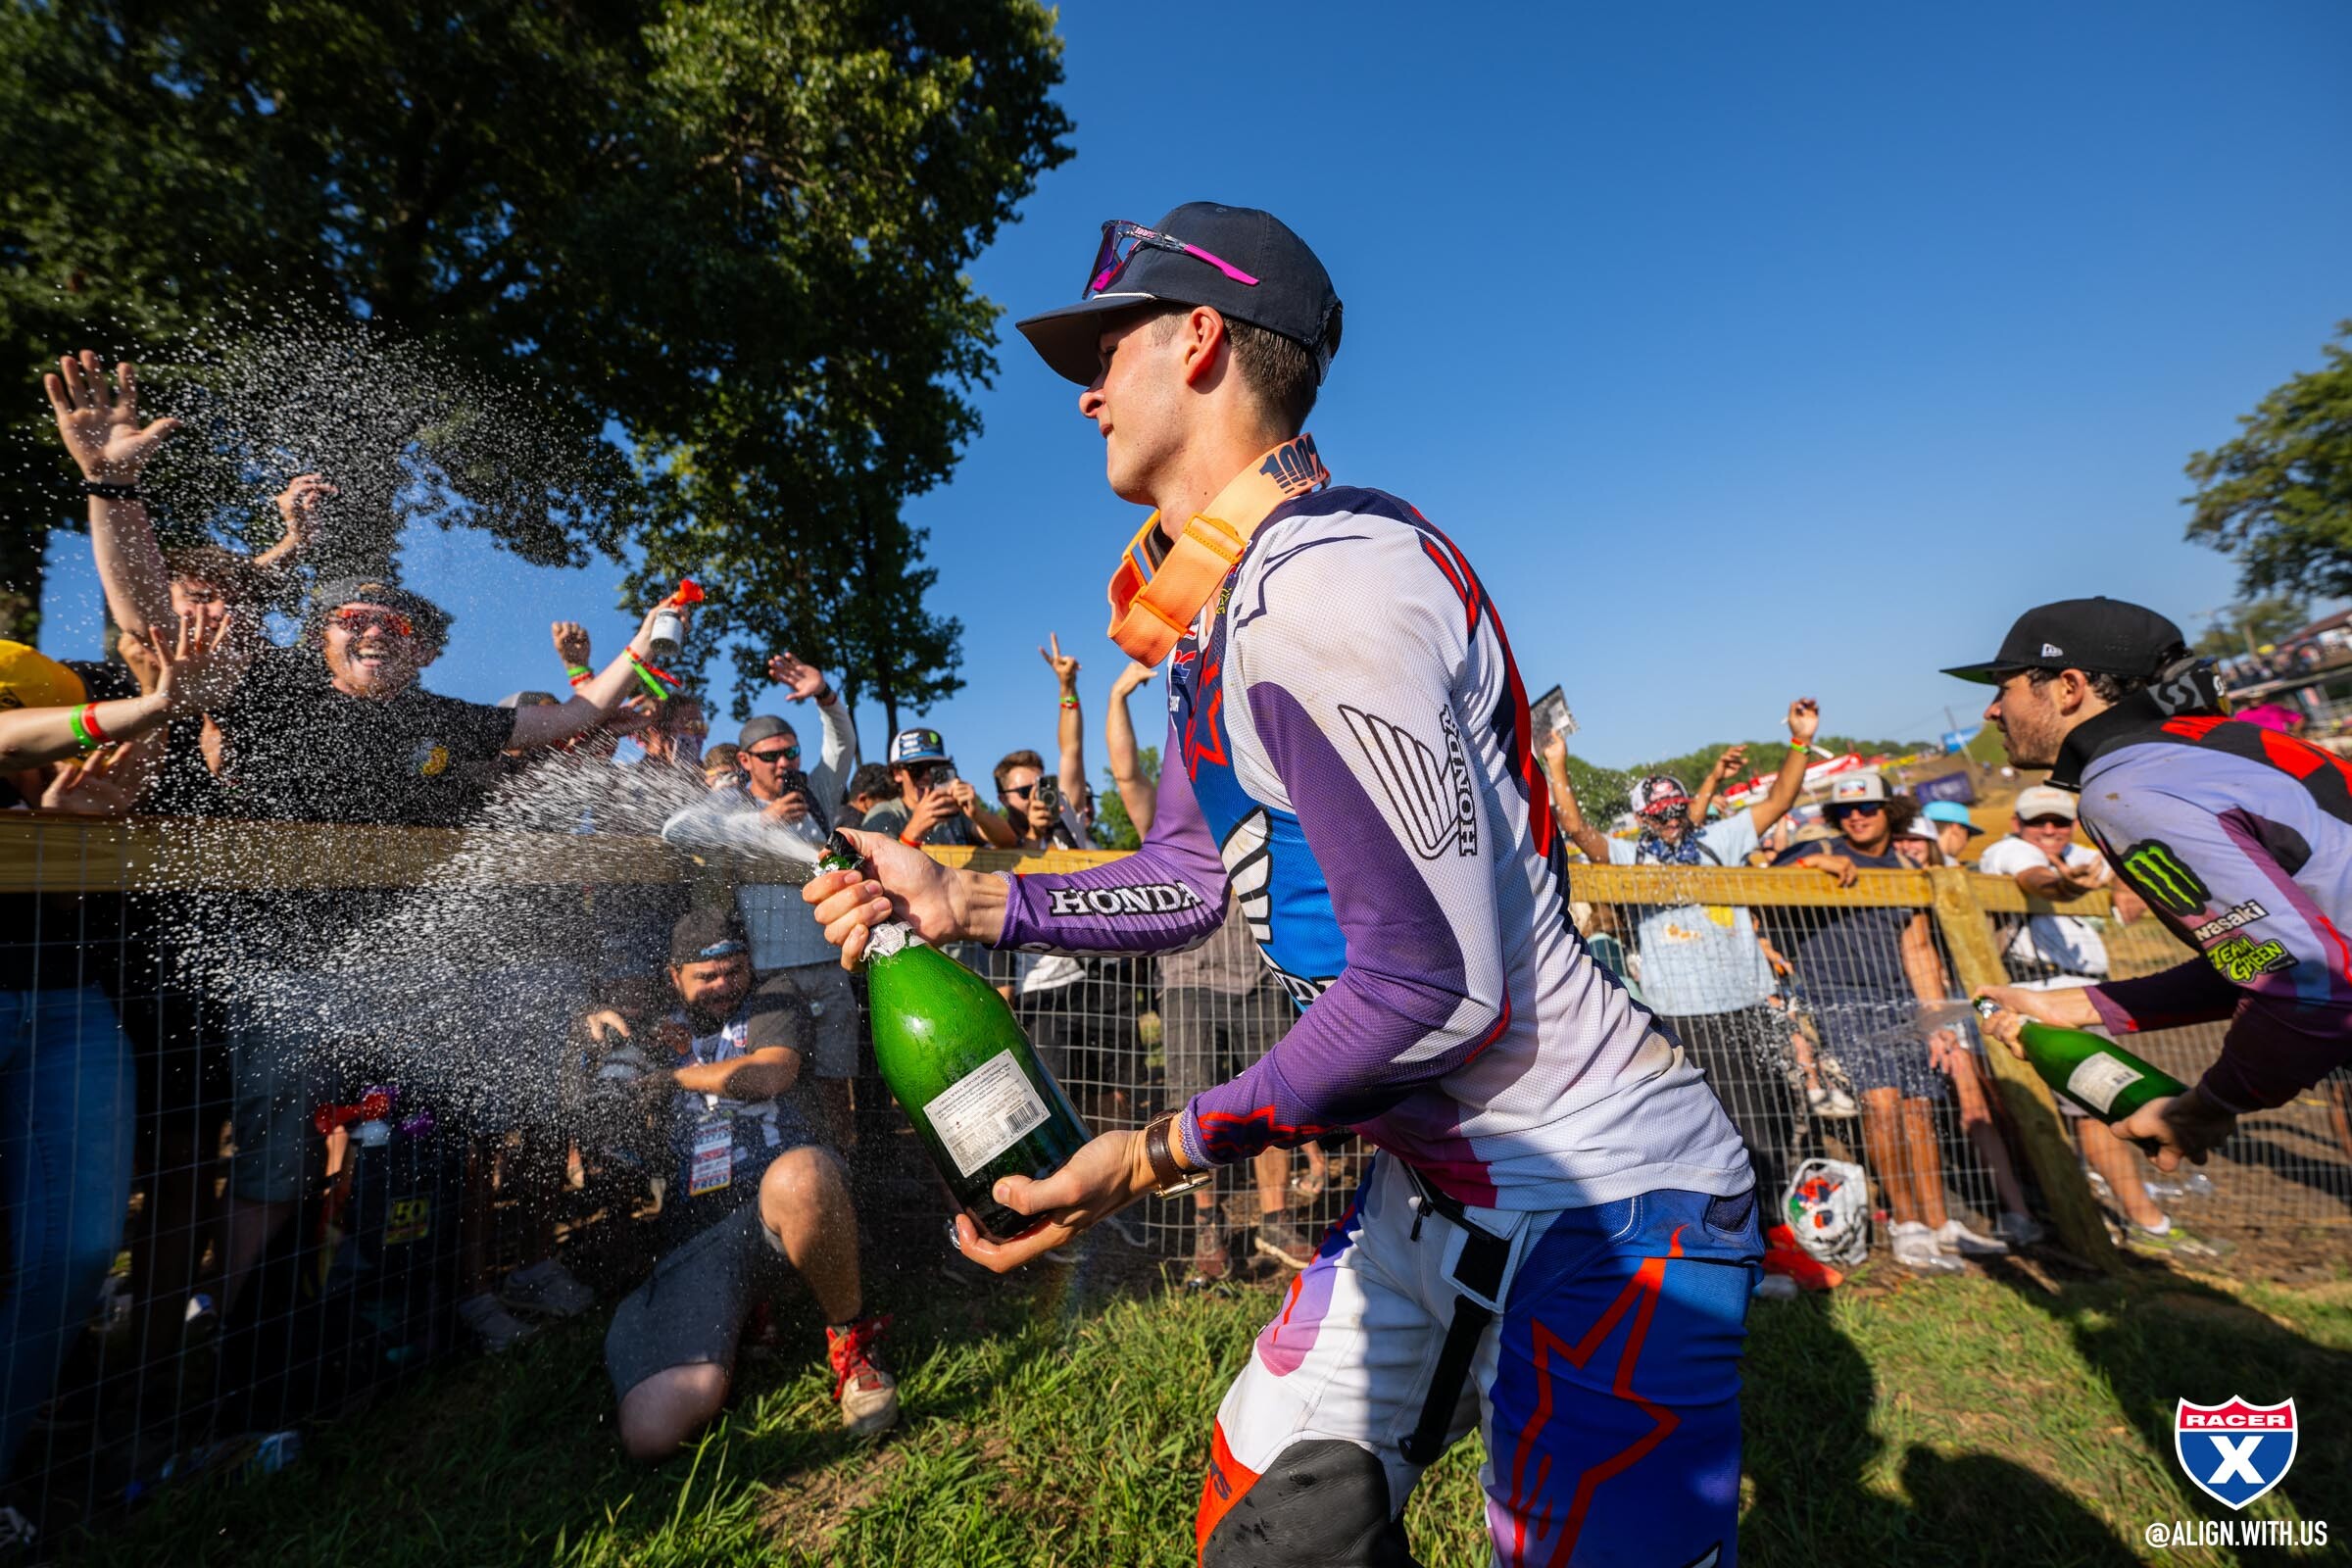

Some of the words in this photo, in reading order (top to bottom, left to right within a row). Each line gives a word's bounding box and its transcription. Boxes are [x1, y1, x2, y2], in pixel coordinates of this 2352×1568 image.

[1439, 704, 1477, 857] HONDA
[1049, 881, 1204, 916] HONDA
[2207, 937, 2255, 969] TEAM
[2230, 941, 2283, 981] GREEN
